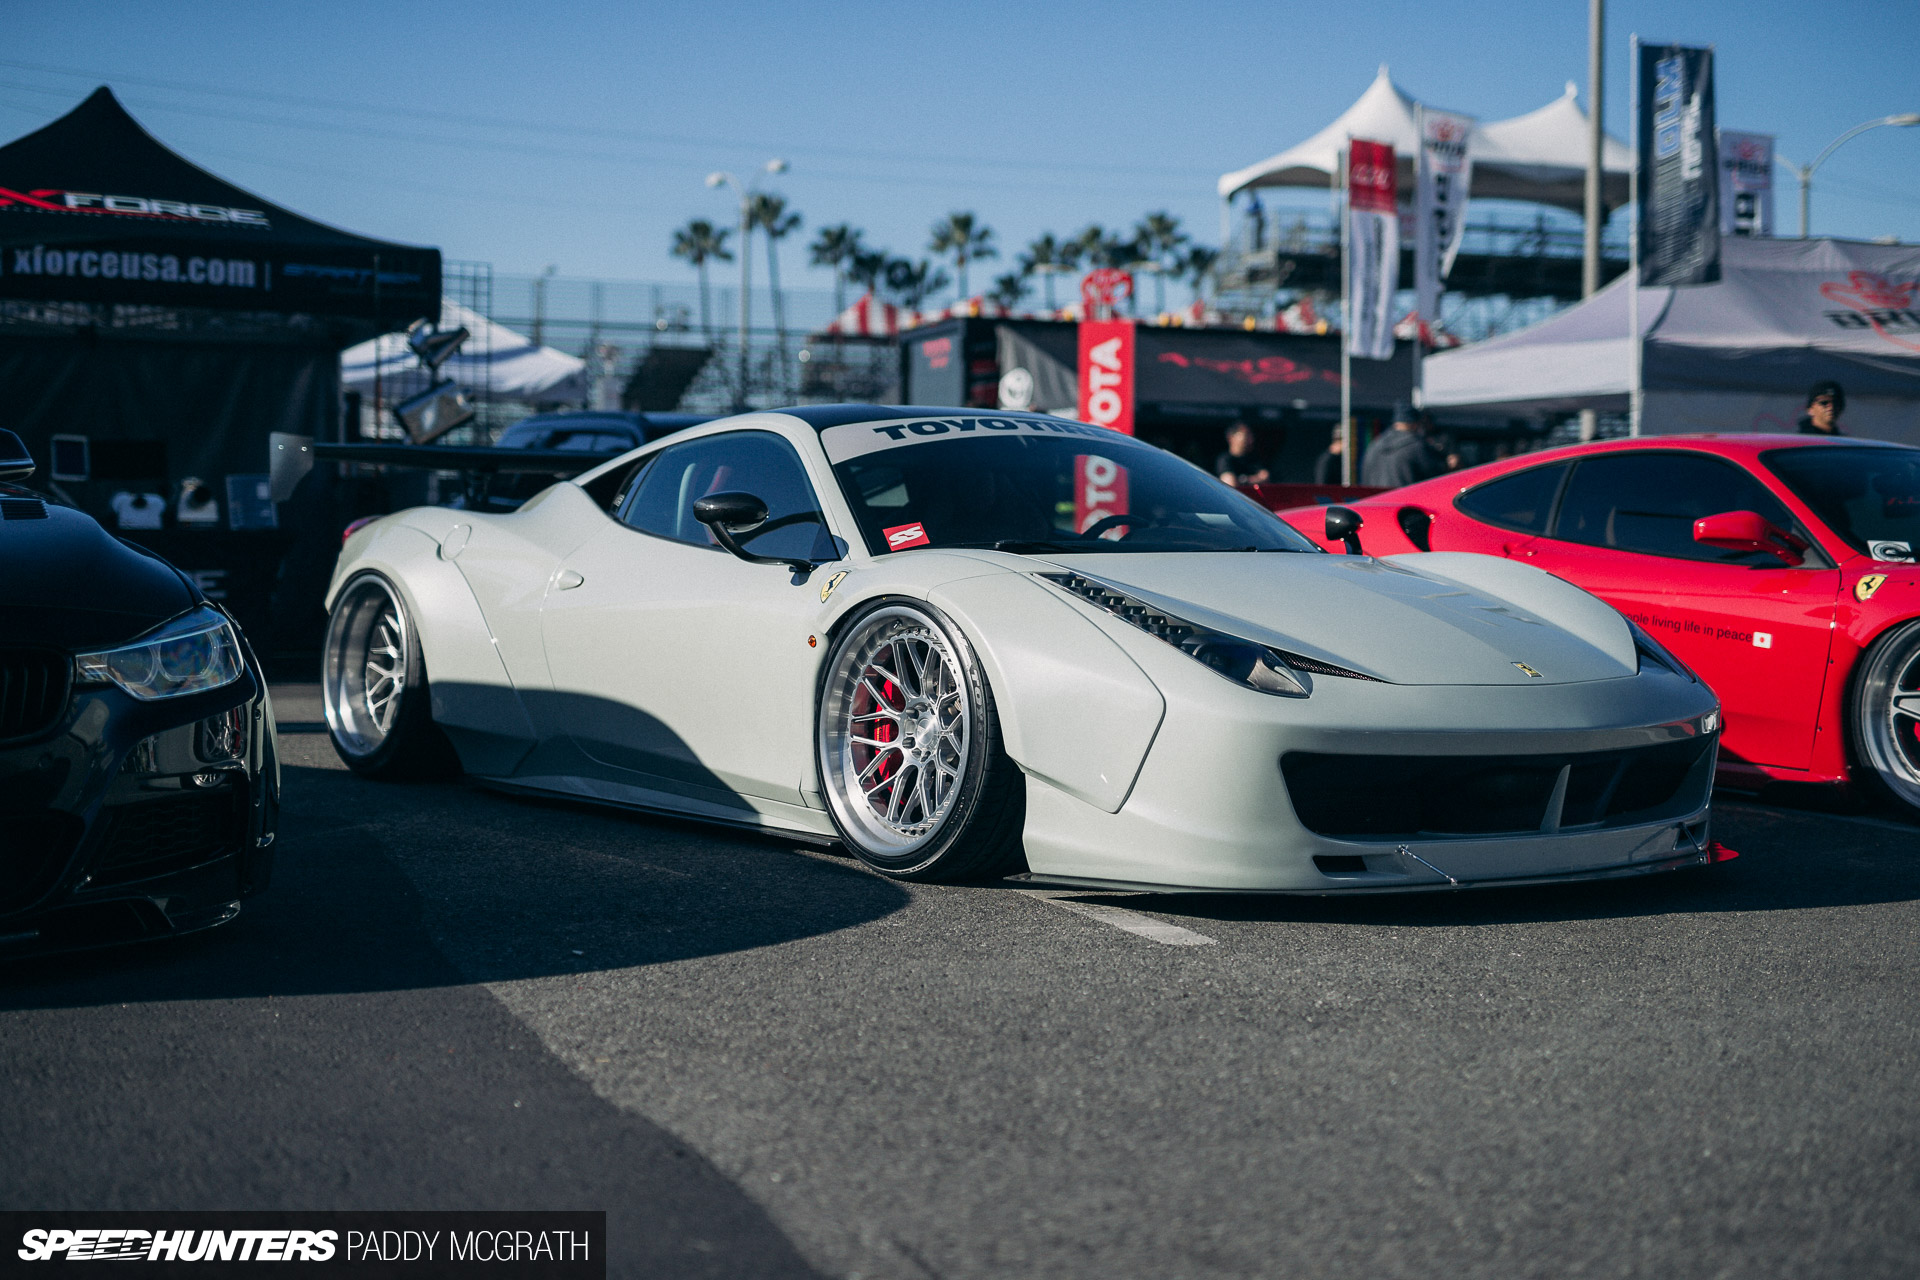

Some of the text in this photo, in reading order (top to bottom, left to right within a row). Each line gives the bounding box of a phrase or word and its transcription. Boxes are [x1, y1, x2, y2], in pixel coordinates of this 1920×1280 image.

[13, 244, 256, 288] xforceusa.com
[1652, 615, 1680, 633] living
[1684, 620, 1701, 634] life
[1703, 624, 1713, 637] in
[1717, 628, 1752, 642] peace
